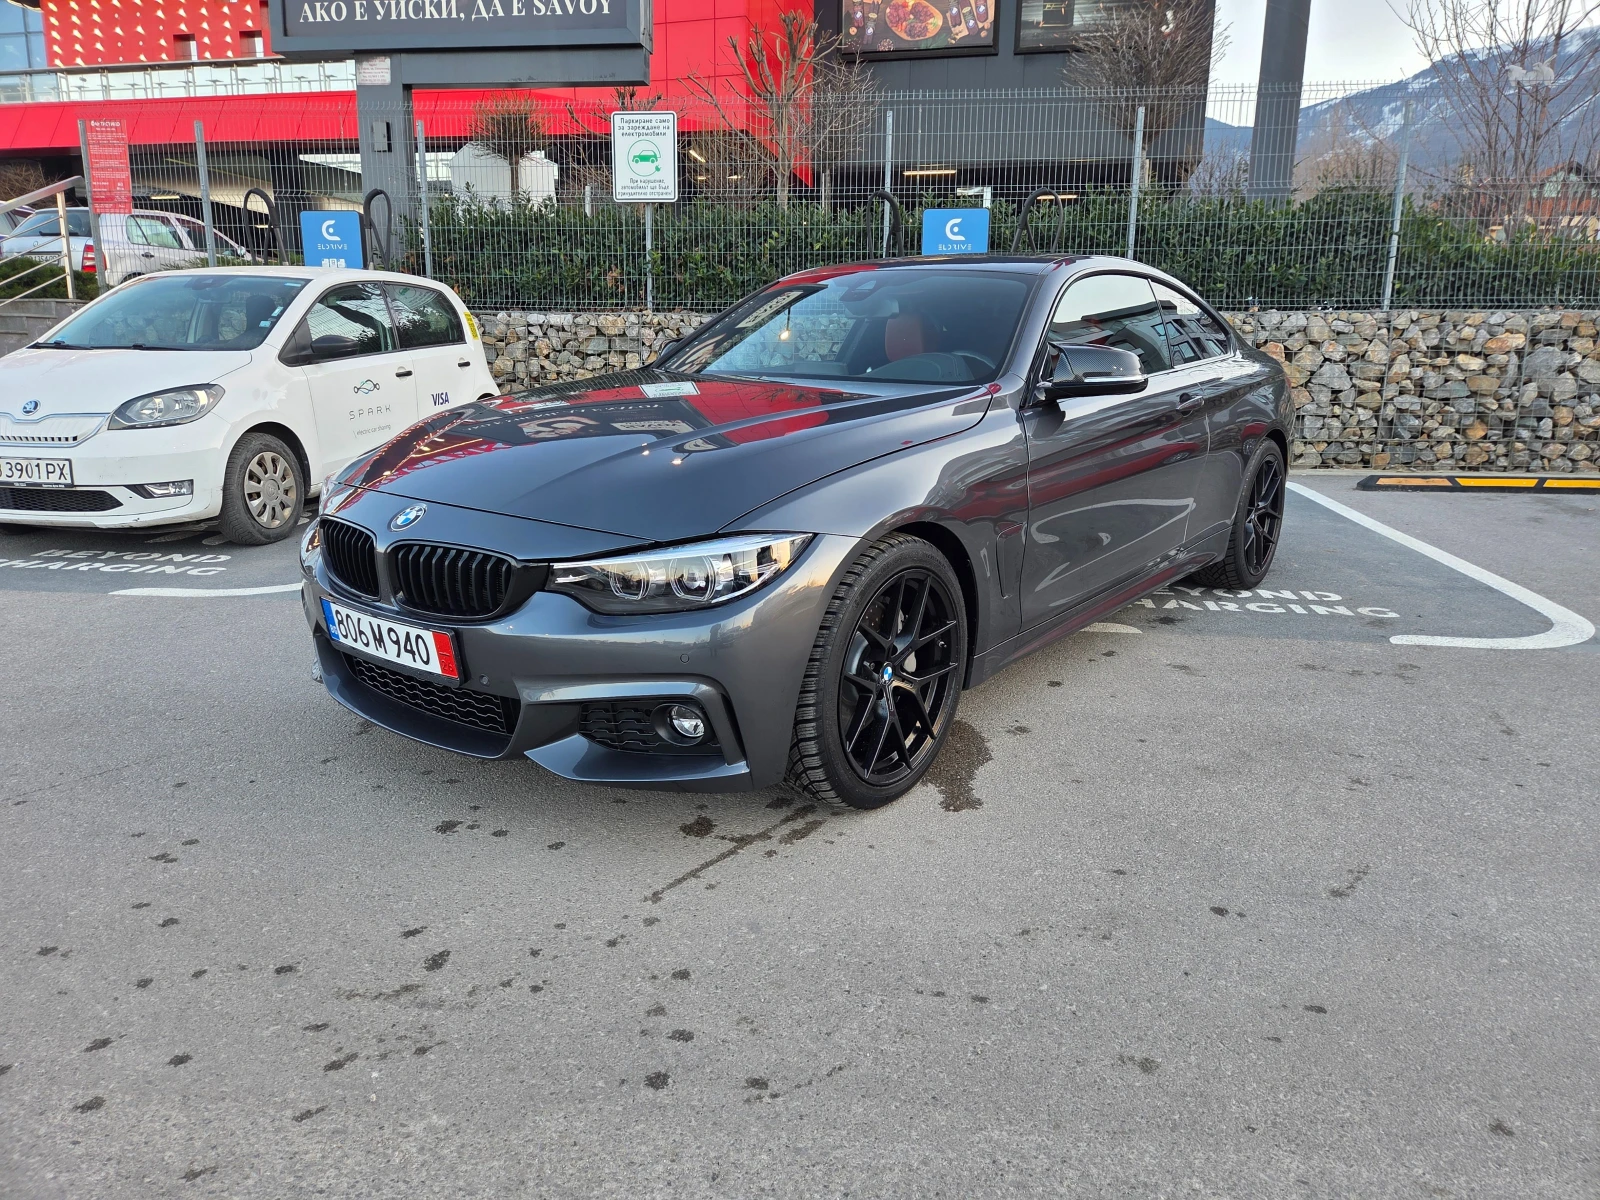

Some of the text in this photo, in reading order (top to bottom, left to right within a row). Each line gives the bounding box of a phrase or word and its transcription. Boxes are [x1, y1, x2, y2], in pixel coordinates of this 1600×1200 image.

[299, 2, 347, 23] АКО
[354, 1, 368, 21] Е
[471, 0, 505, 22] ДА
[511, 0, 526, 16] Е
[533, 0, 611, 16] SAVOY
[620, 117, 653, 125] Паркиране
[938, 243, 972, 251] ELDRIVE
[430, 391, 450, 406] VISA
[348, 404, 392, 421] SPARK
[30, 549, 231, 563] BEYOND
[0, 558, 227, 576] HARGING
[1152, 586, 1342, 601] EYOND
